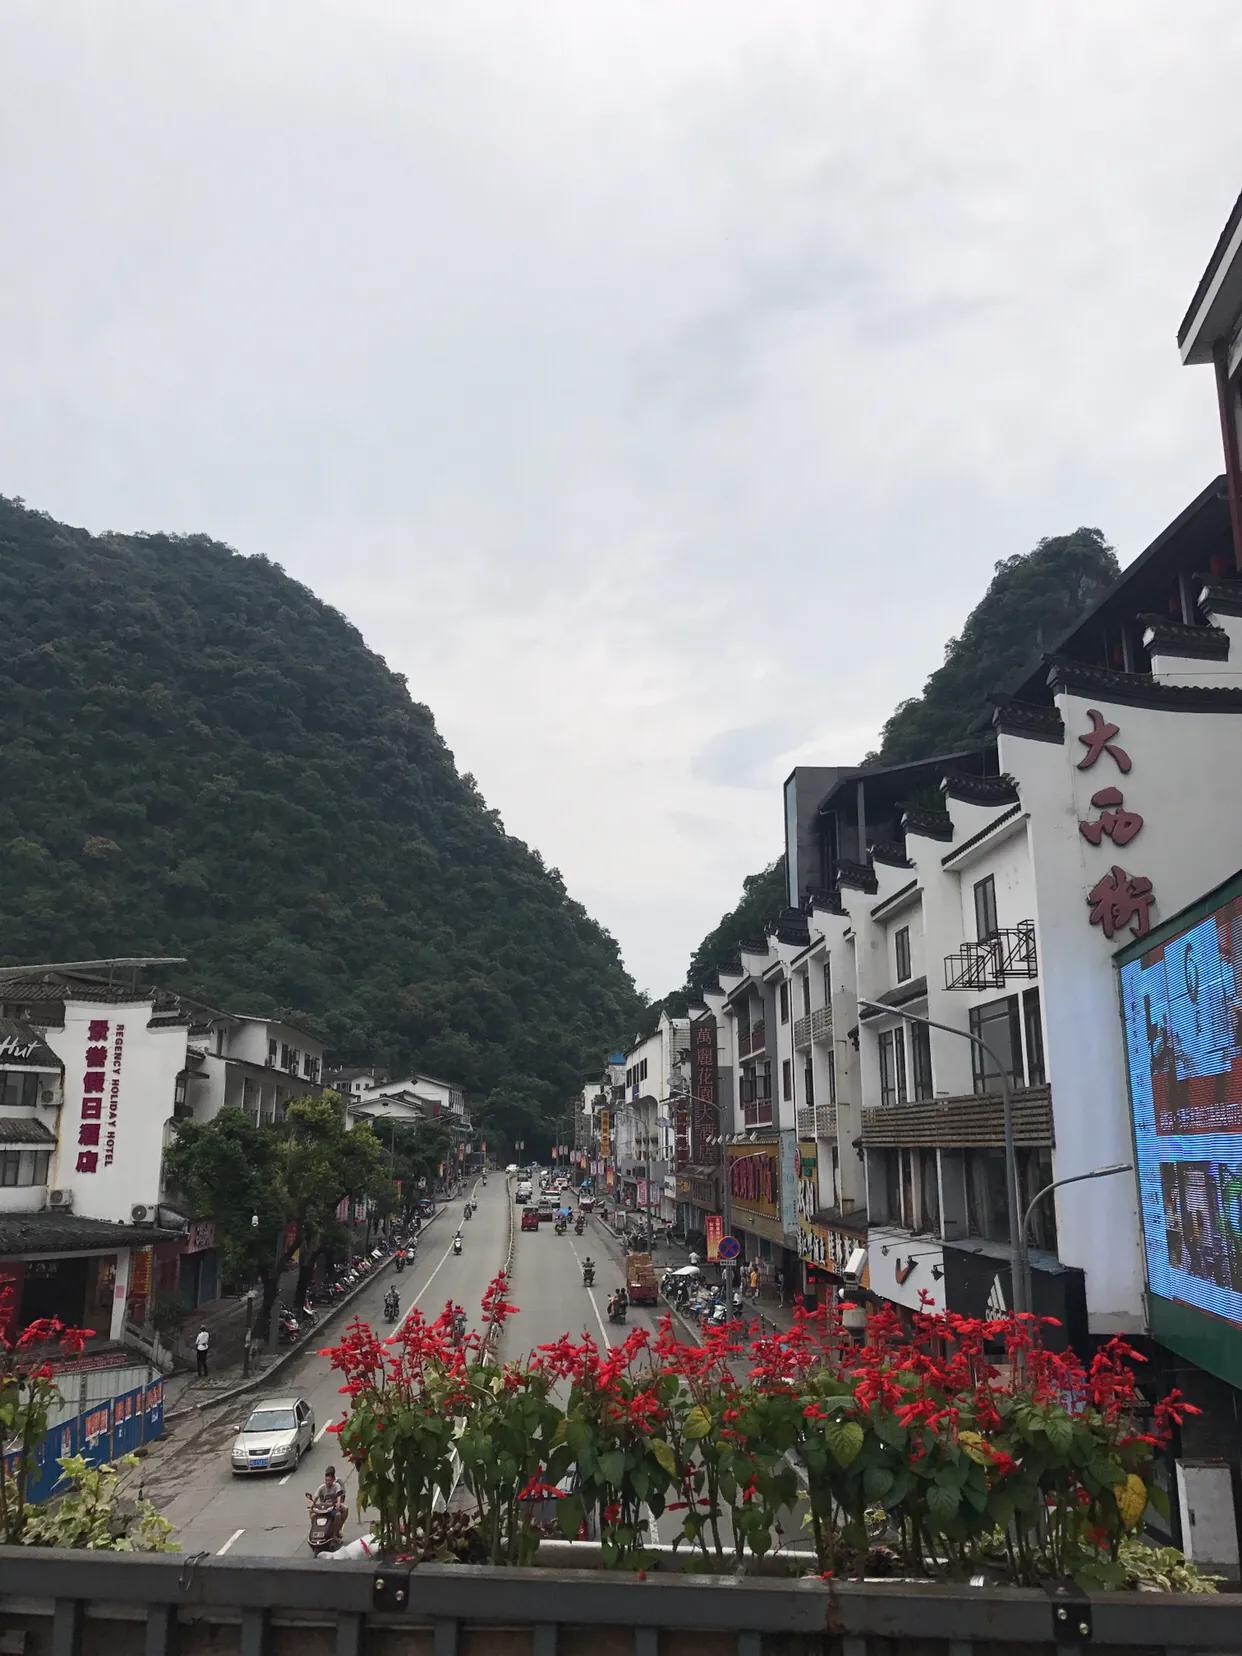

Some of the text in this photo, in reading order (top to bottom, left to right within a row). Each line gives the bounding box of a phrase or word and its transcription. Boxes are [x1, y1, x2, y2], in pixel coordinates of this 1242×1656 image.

[1077, 708, 1156, 939] 大西街
[0, 1035, 42, 1058] Hut
[104, 1024, 125, 1168] REGENCY HOLIDAY HOTEL
